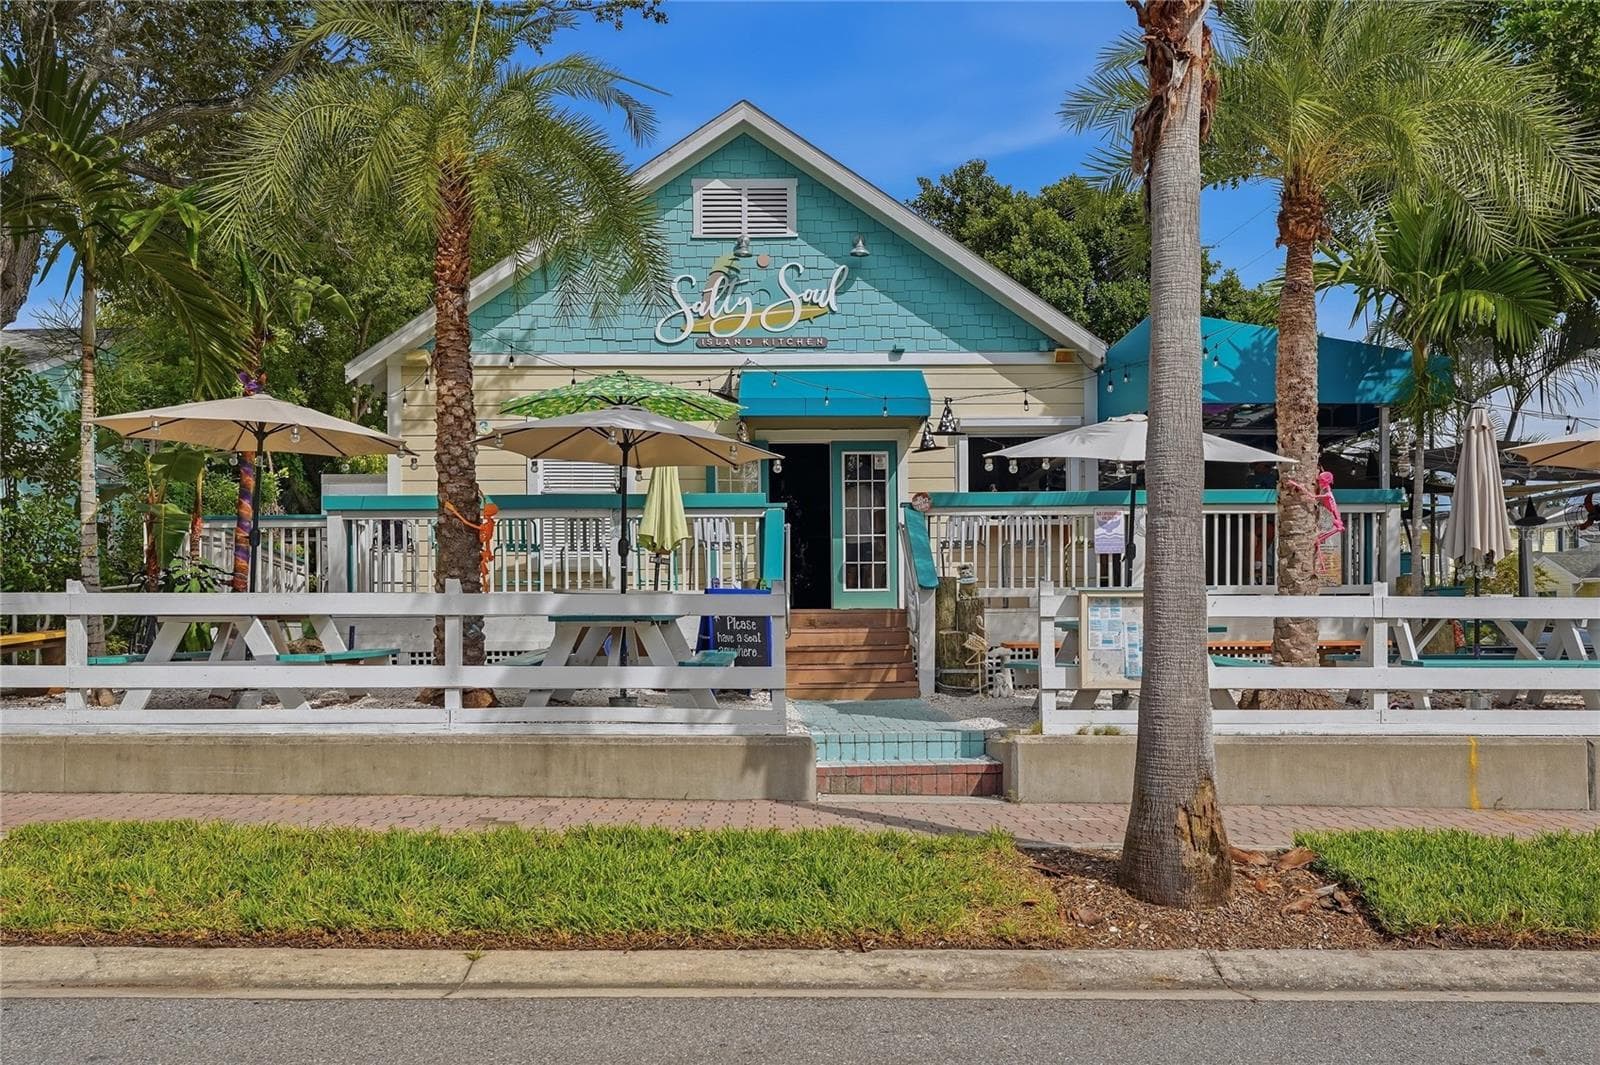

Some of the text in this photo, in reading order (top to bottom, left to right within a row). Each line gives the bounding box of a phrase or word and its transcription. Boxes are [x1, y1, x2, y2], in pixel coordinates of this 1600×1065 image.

[655, 261, 849, 344] Salty Soul
[701, 338, 824, 346] ISLAND KITCHEN
[726, 616, 757, 630] Please
[717, 631, 761, 643] have a seat
